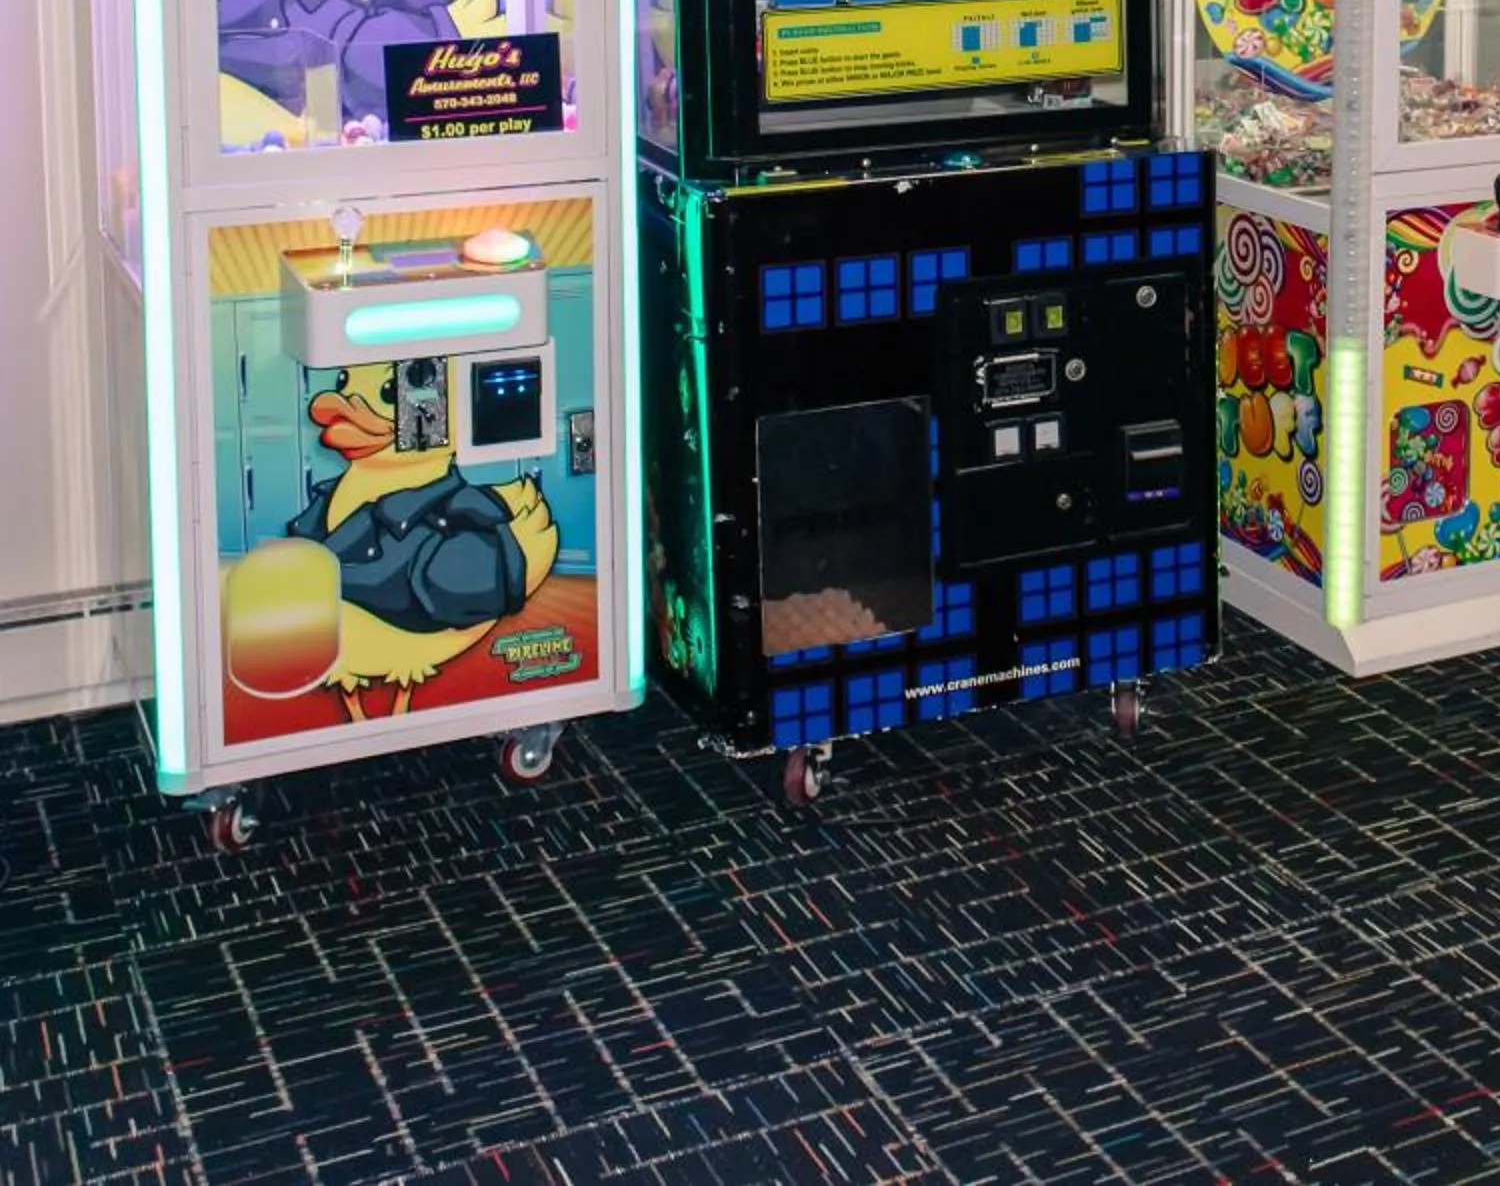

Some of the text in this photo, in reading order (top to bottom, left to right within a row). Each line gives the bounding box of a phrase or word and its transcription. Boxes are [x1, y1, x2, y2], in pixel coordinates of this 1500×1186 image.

[426, 42, 522, 75] Hugo's
[420, 117, 532, 139] $1.00 per play
[904, 655, 1081, 699] www.cranemachines.com
